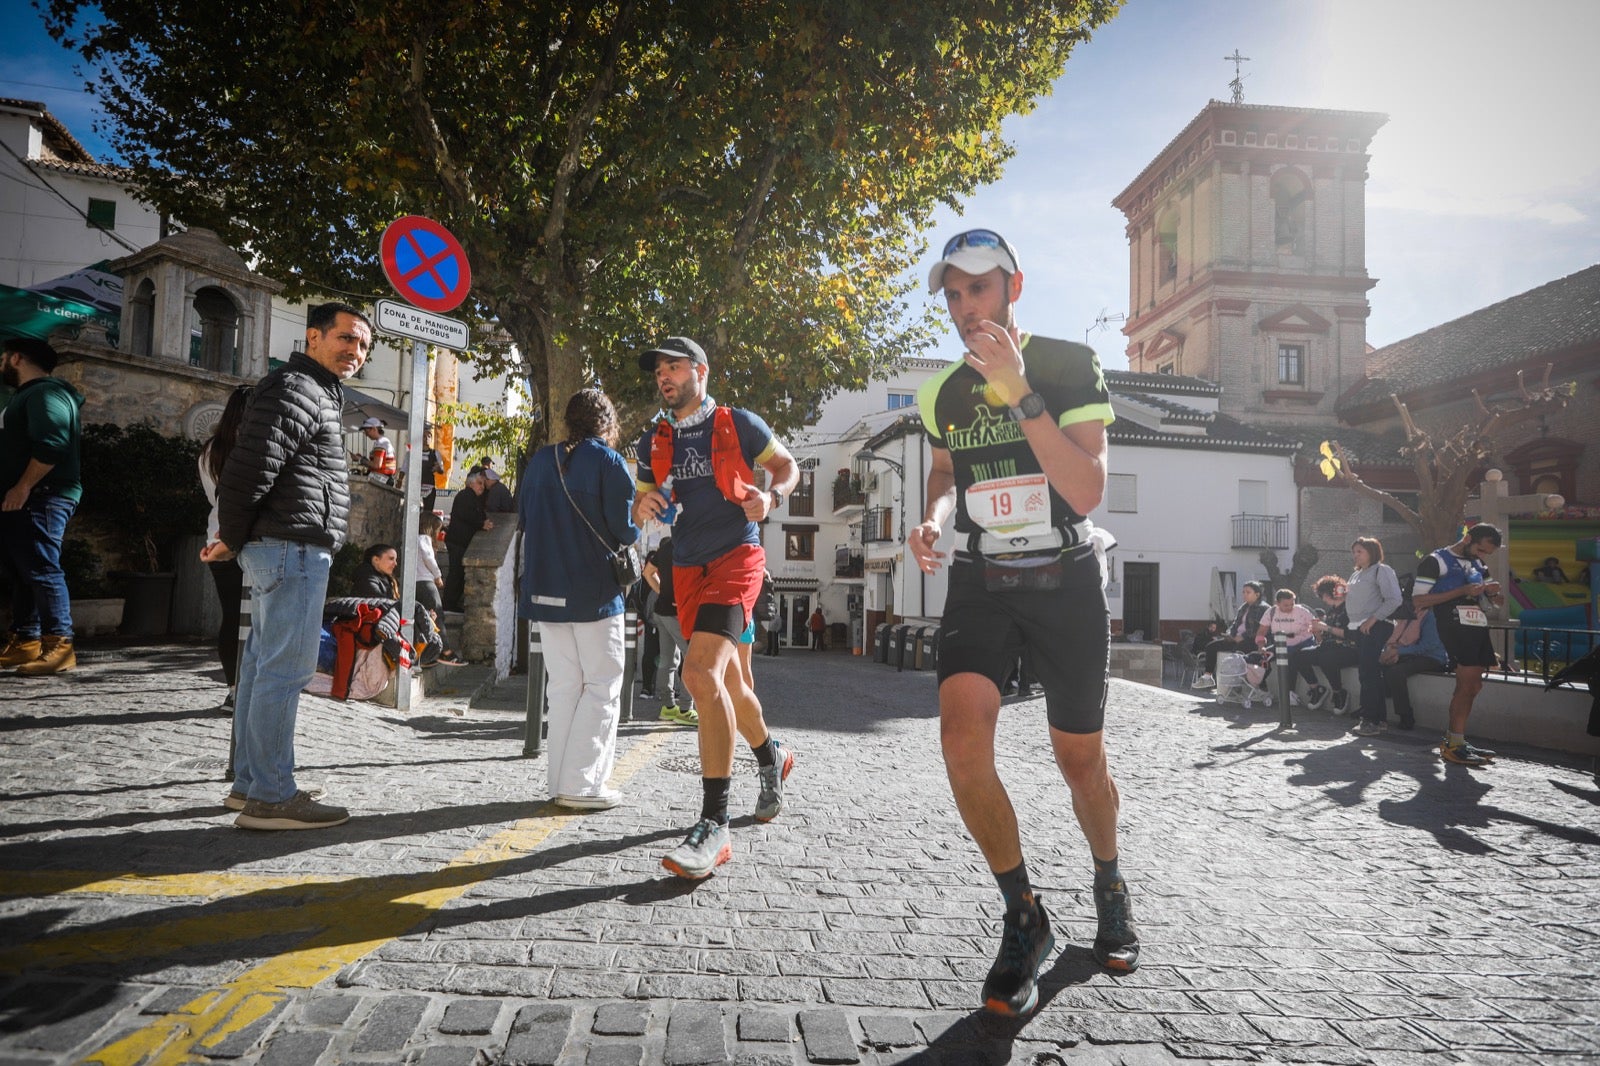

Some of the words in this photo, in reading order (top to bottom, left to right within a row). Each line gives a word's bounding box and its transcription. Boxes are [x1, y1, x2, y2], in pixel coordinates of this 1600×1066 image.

[37, 302, 51, 313] La
[100, 318, 115, 327] de
[384, 307, 406, 320] ZONA
[411, 315, 421, 323] DE
[425, 319, 463, 335] MANIOBRA
[399, 320, 410, 329] DE
[414, 324, 450, 339] AUTOBUS
[990, 492, 1012, 517] 19
